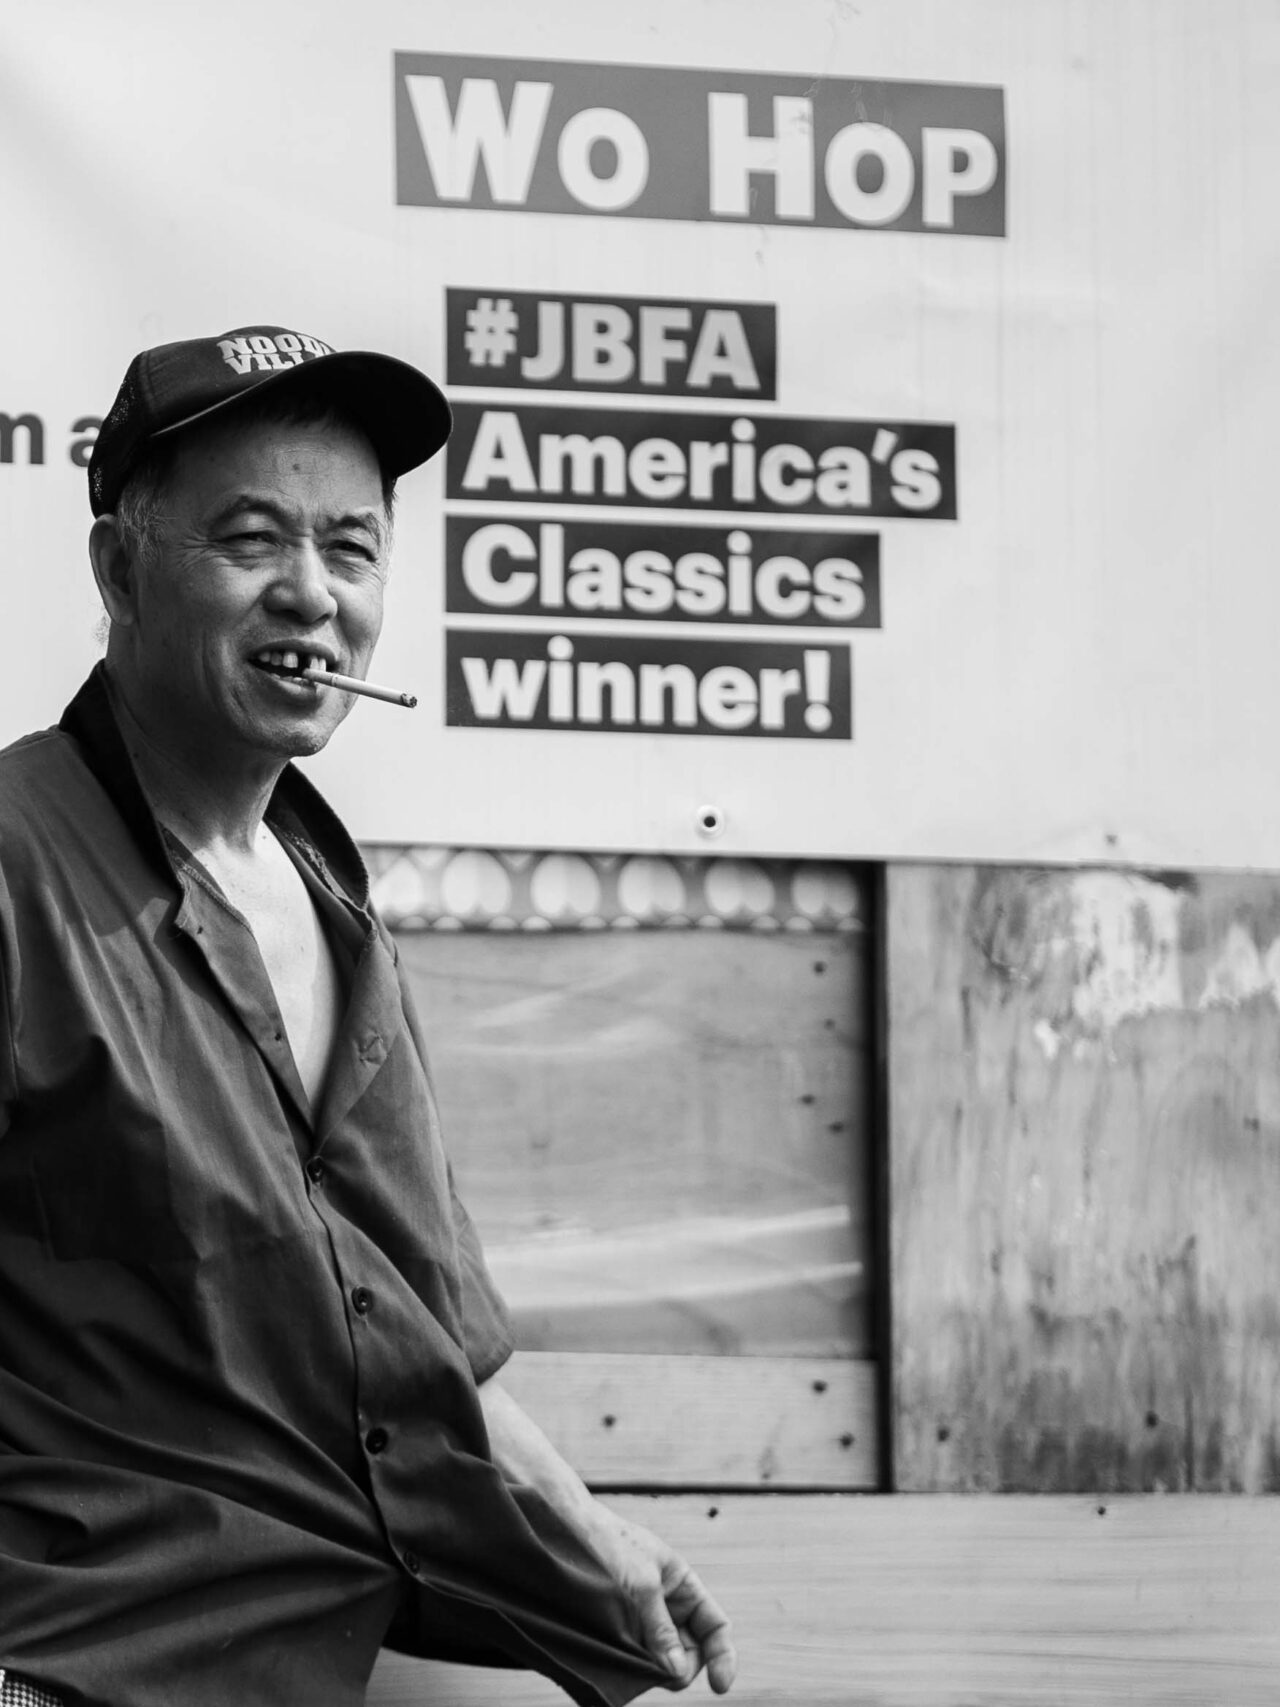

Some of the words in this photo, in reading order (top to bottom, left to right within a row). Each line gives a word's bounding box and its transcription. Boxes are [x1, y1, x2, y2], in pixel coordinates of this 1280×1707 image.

[216, 333, 336, 360] NOOD
[465, 298, 761, 390] #JBFA
[461, 410, 943, 511] America’s
[461, 523, 866, 621] Classics
[461, 635, 832, 732] winner!
